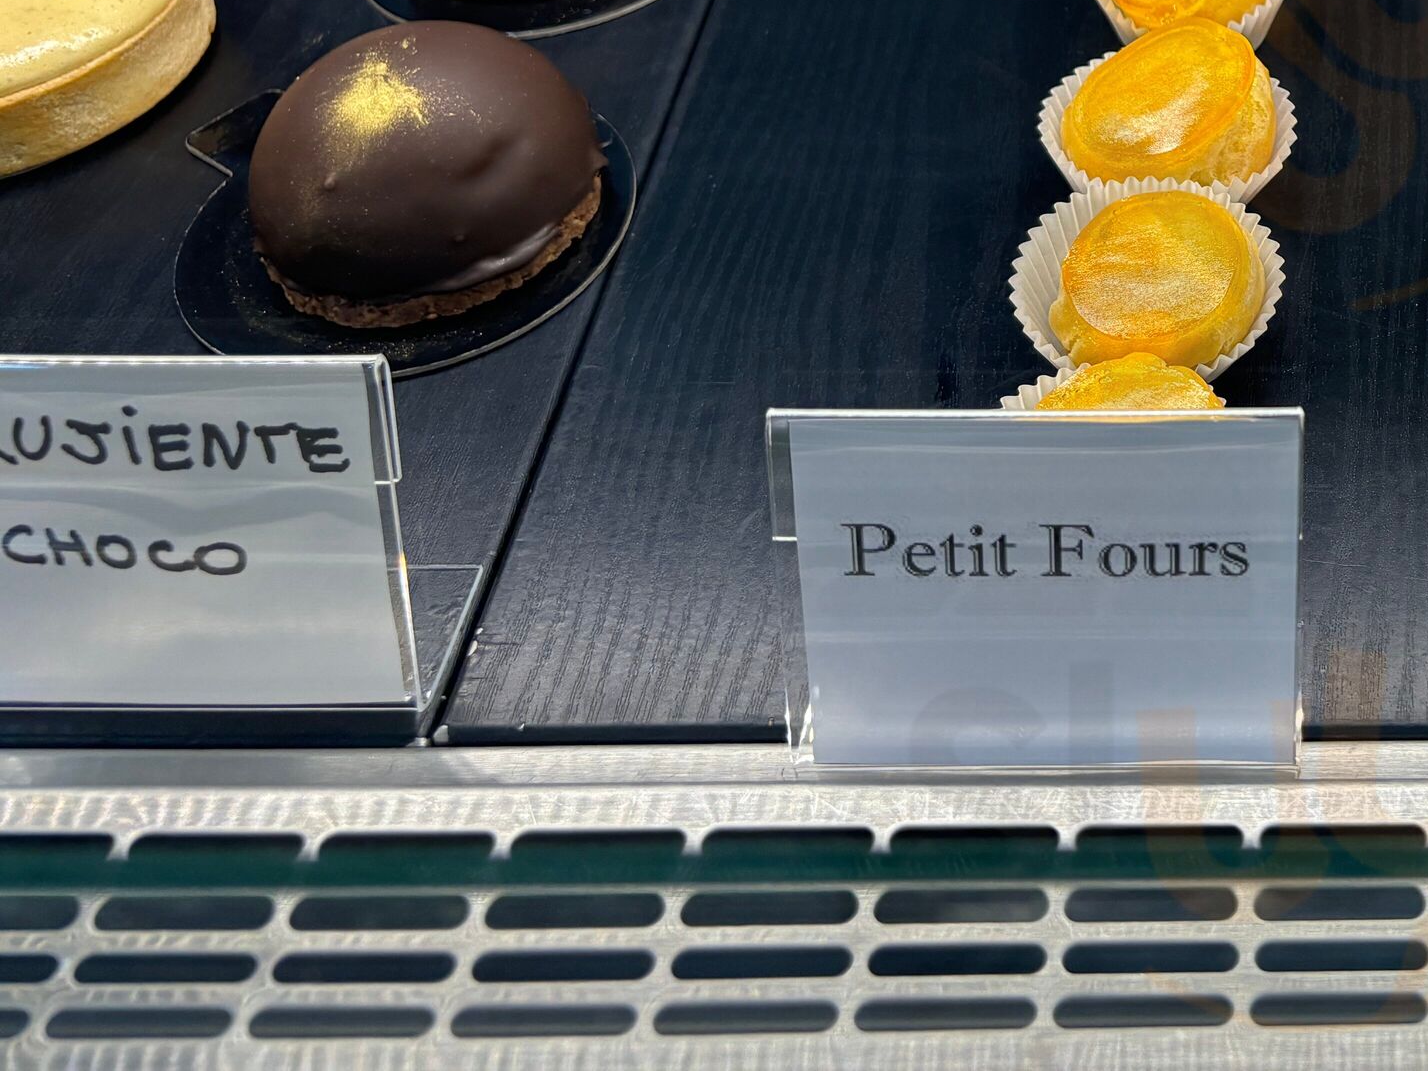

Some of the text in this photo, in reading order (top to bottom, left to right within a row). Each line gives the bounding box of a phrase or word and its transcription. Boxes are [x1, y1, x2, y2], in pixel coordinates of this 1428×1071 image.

[2, 524, 248, 576] CHOCO
[840, 523, 1251, 578] Petit Fours
